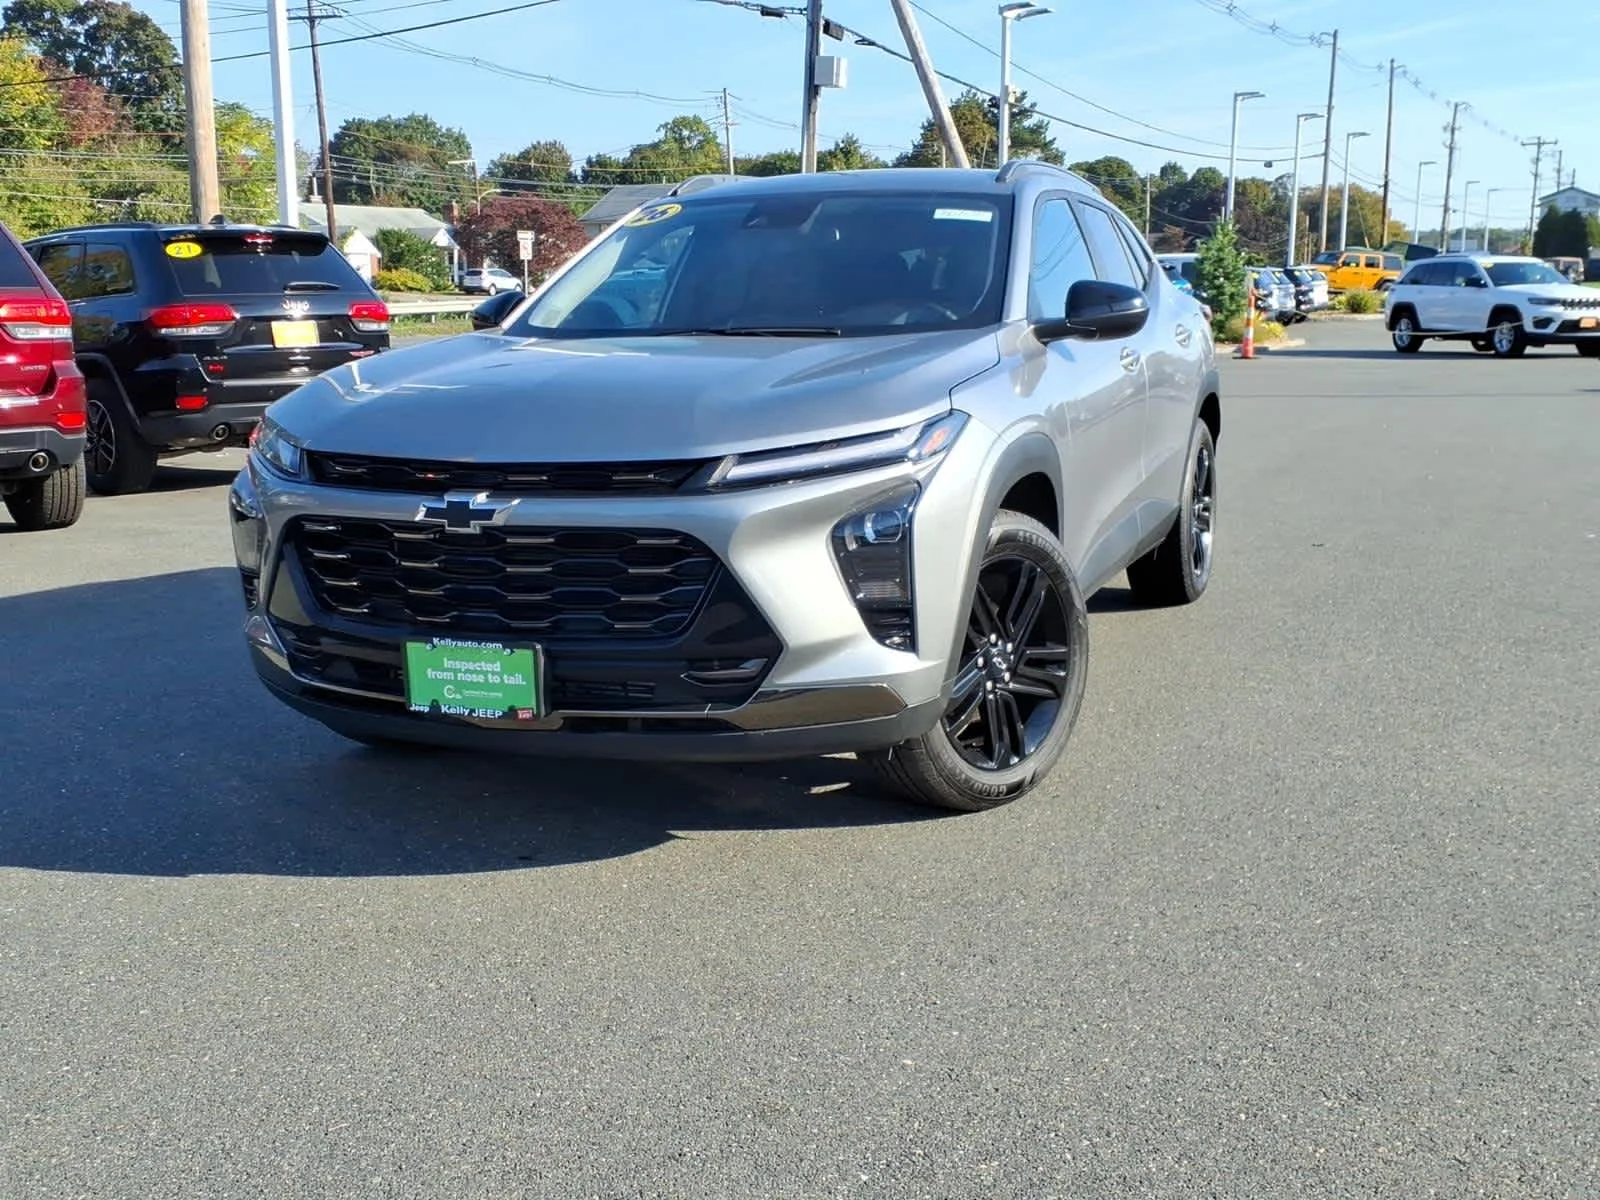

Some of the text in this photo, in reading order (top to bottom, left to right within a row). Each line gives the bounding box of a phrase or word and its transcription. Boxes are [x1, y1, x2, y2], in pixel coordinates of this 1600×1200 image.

[174, 244, 192, 256] 21
[433, 637, 503, 649] Kellyauto.com
[443, 657, 501, 671] Inspected
[427, 668, 527, 686] from nose to tail.
[409, 703, 430, 713] Jeep
[441, 704, 470, 716] Kelly
[471, 707, 503, 719] JEEP
